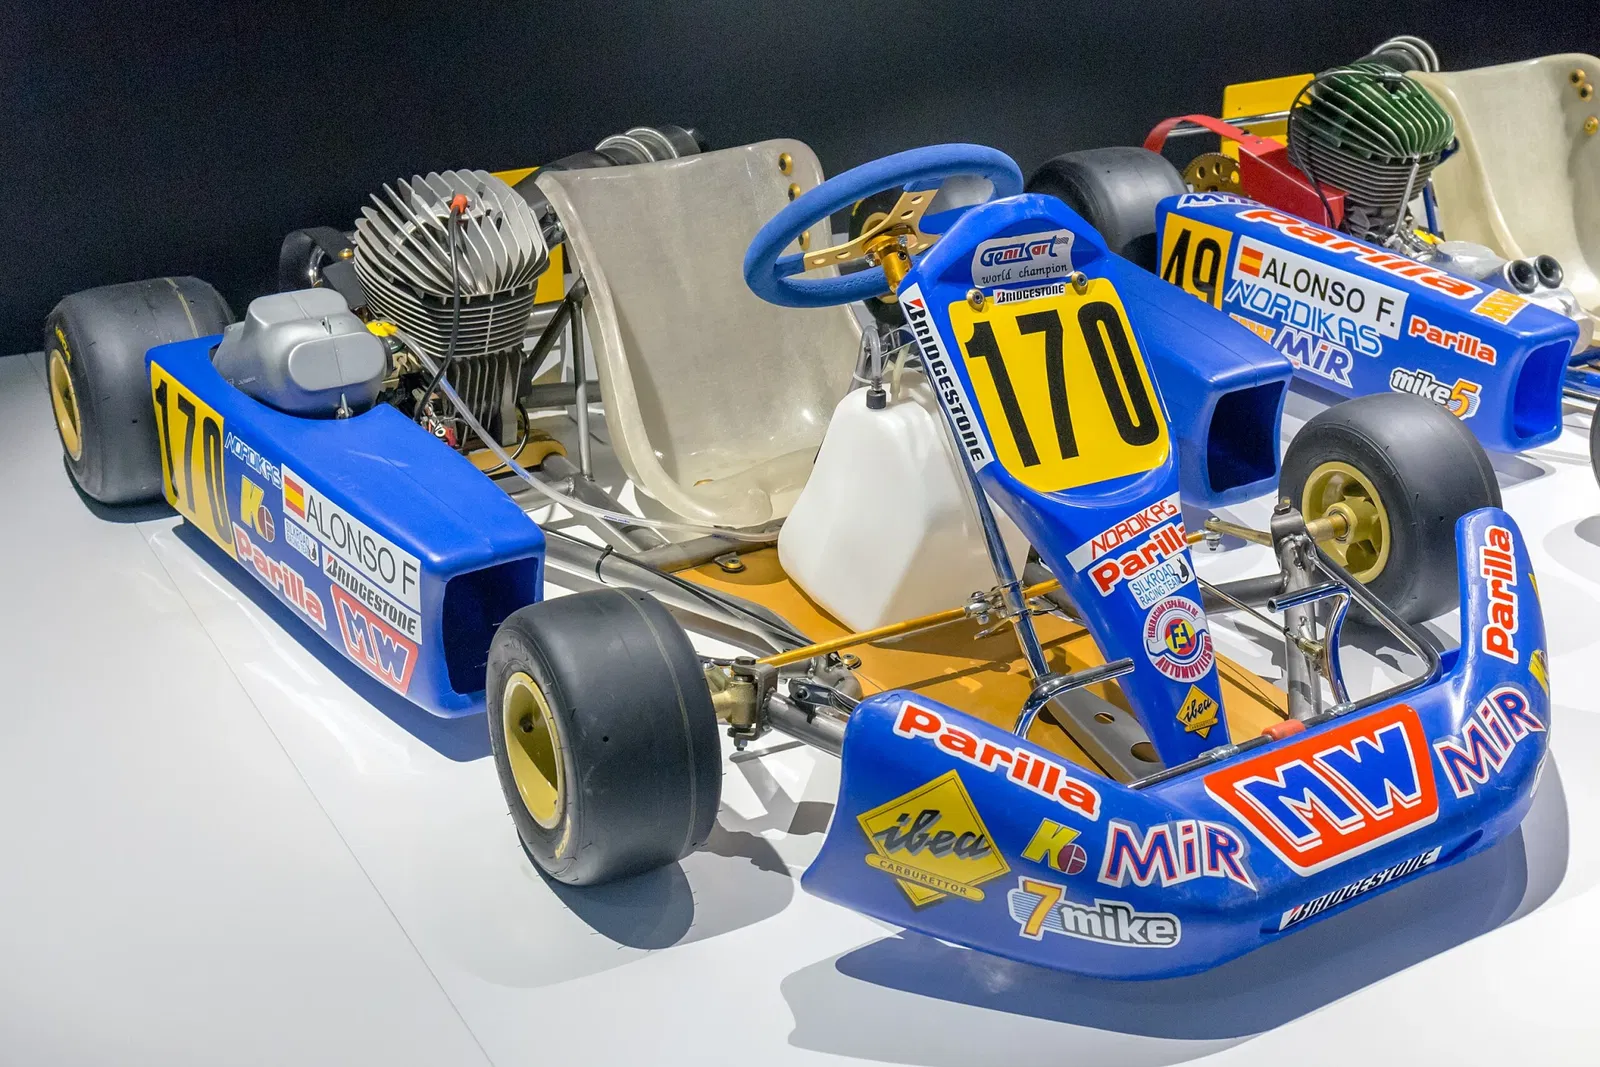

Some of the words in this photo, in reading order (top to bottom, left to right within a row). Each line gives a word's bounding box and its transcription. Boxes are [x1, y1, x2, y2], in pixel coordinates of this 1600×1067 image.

[982, 268, 1012, 285] world
[1018, 263, 1068, 281] champion
[1162, 228, 1222, 306] 49
[1243, 210, 1476, 297] Parilla
[1262, 257, 1365, 313] ALONSO
[1376, 297, 1395, 327] F.
[996, 283, 1065, 303] BRIDGESTONE
[1225, 279, 1381, 356] NORDIKAS
[1410, 317, 1495, 363] Parilla
[903, 298, 985, 463] BRIDGESTONE
[964, 301, 1160, 468] 170
[1391, 370, 1451, 405] mike
[155, 378, 232, 545] 170
[306, 495, 396, 584] ALONSO
[402, 560, 417, 595] F
[1091, 500, 1178, 560] NORDIKAS
[236, 532, 325, 627] Parilla
[325, 553, 417, 636] BRIDGESTONE
[1131, 563, 1175, 596] SILKROAD
[1140, 586, 1165, 606] RACING
[1165, 576, 1182, 591] TEAM
[1484, 526, 1514, 660] Parilla
[340, 598, 409, 684] MW
[898, 704, 1097, 816] Parilla
[1233, 721, 1423, 854] MW
[873, 809, 992, 860] ibea
[879, 859, 968, 895] CARBURETTOR
[1023, 879, 1064, 936] 7
[1057, 903, 1177, 945] mike
[1284, 850, 1436, 928] BRIDGESTONE
